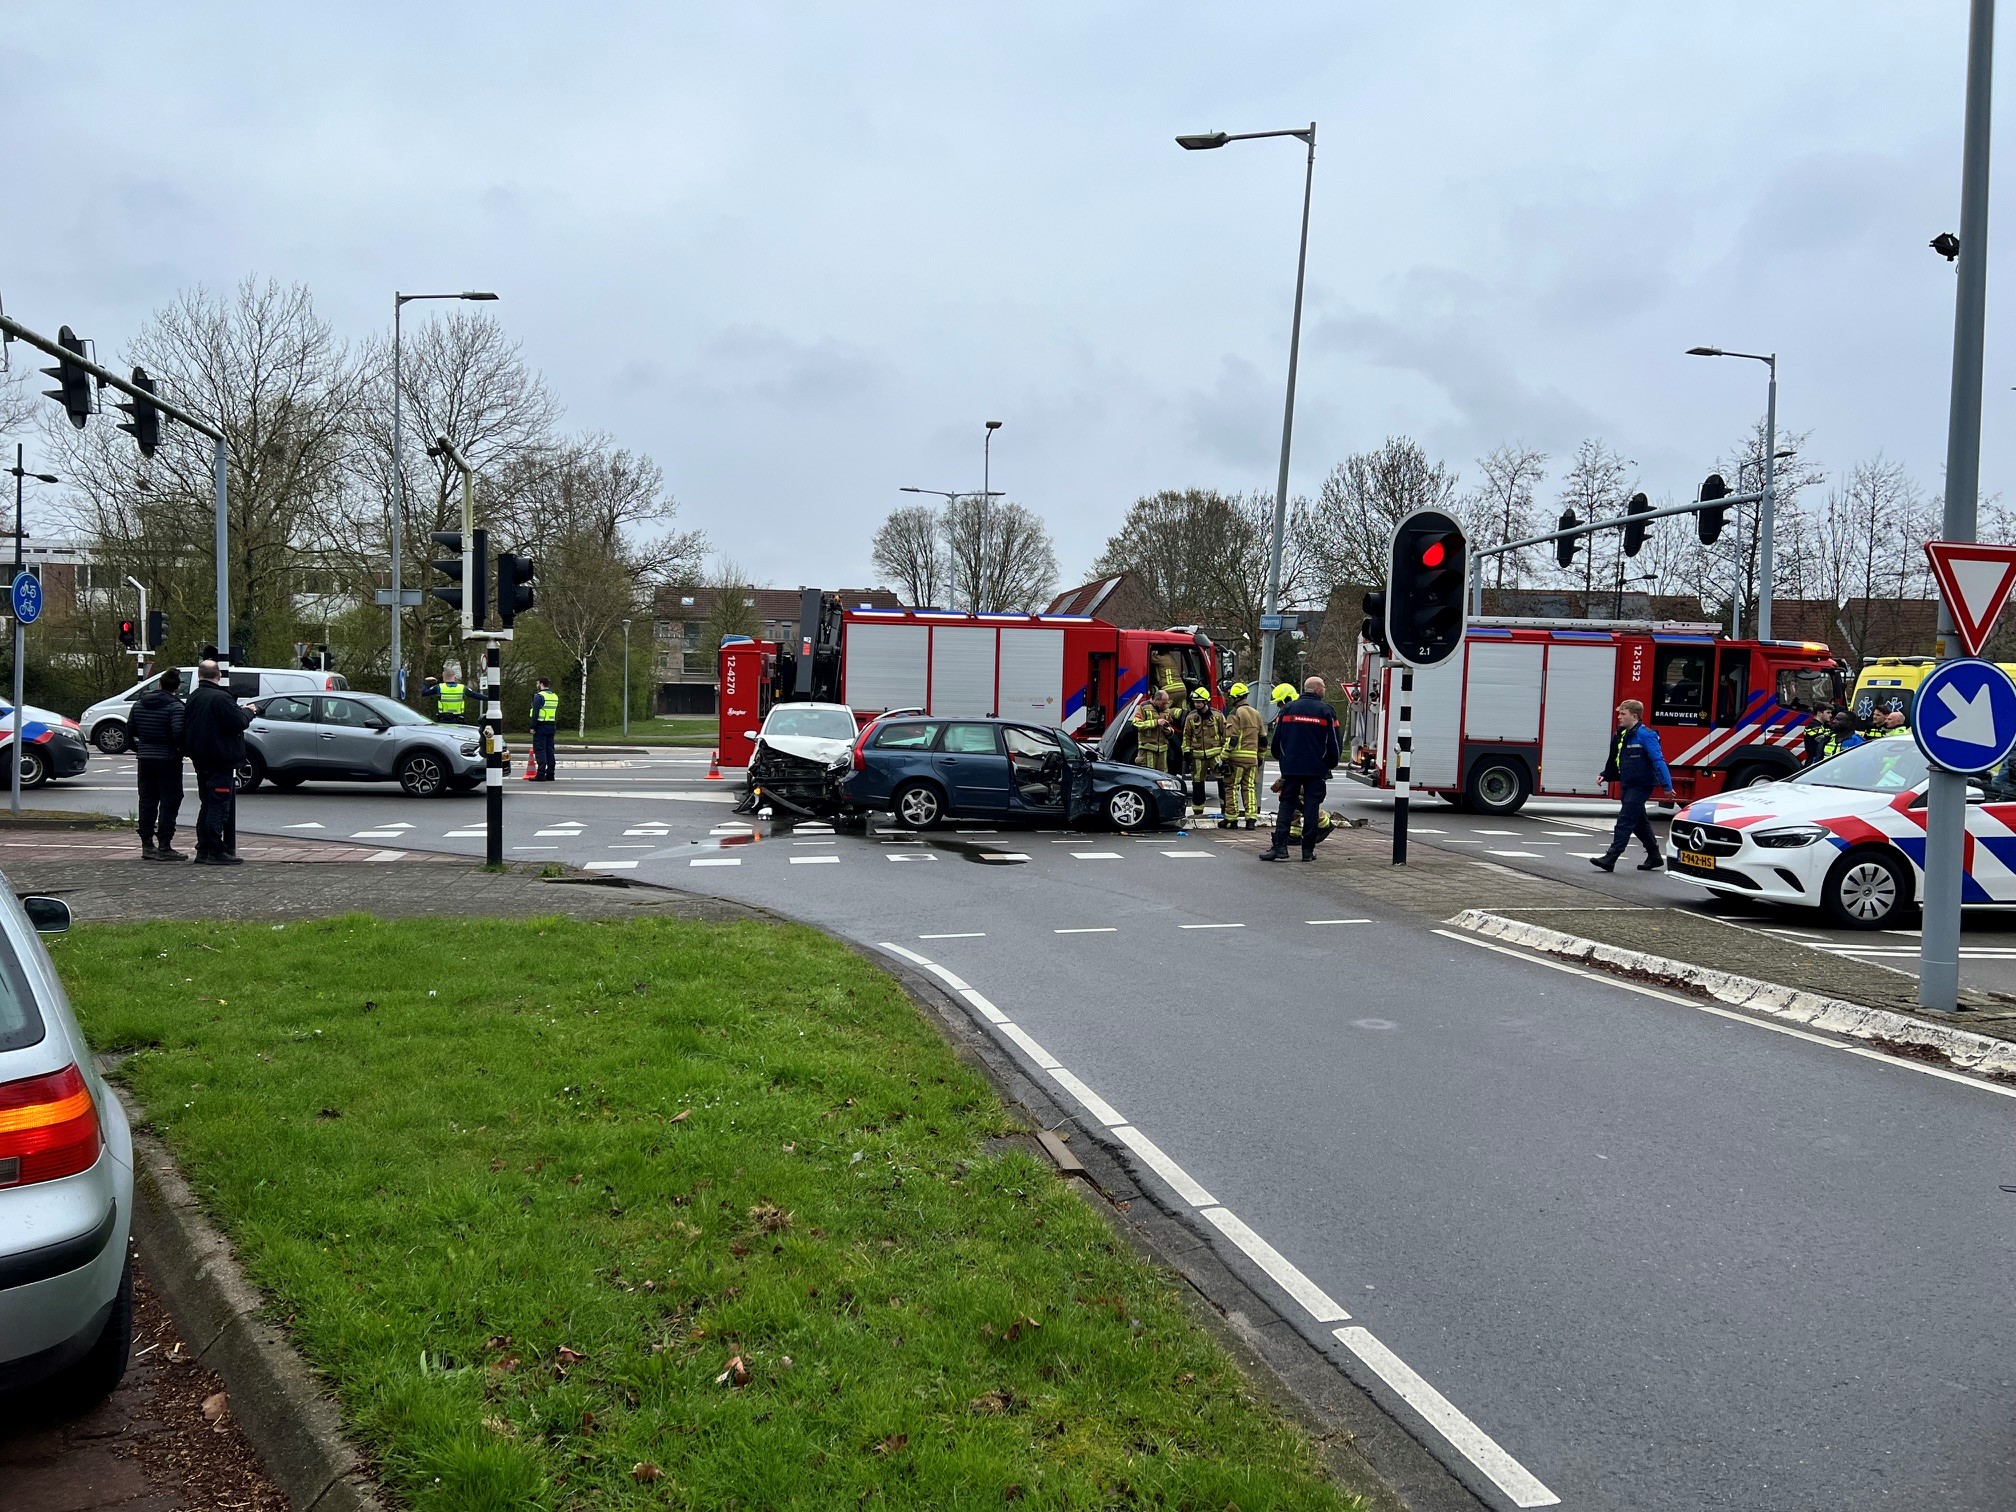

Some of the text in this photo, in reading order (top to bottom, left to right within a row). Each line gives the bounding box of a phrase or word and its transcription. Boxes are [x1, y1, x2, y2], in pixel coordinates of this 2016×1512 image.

[1419, 646, 1431, 656] 2.1
[1632, 645, 1643, 682] 12-1532
[726, 655, 736, 695] 12-4270
[1655, 710, 1698, 719] BRANDWEER
[1681, 852, 1712, 868] Z-942-HS
